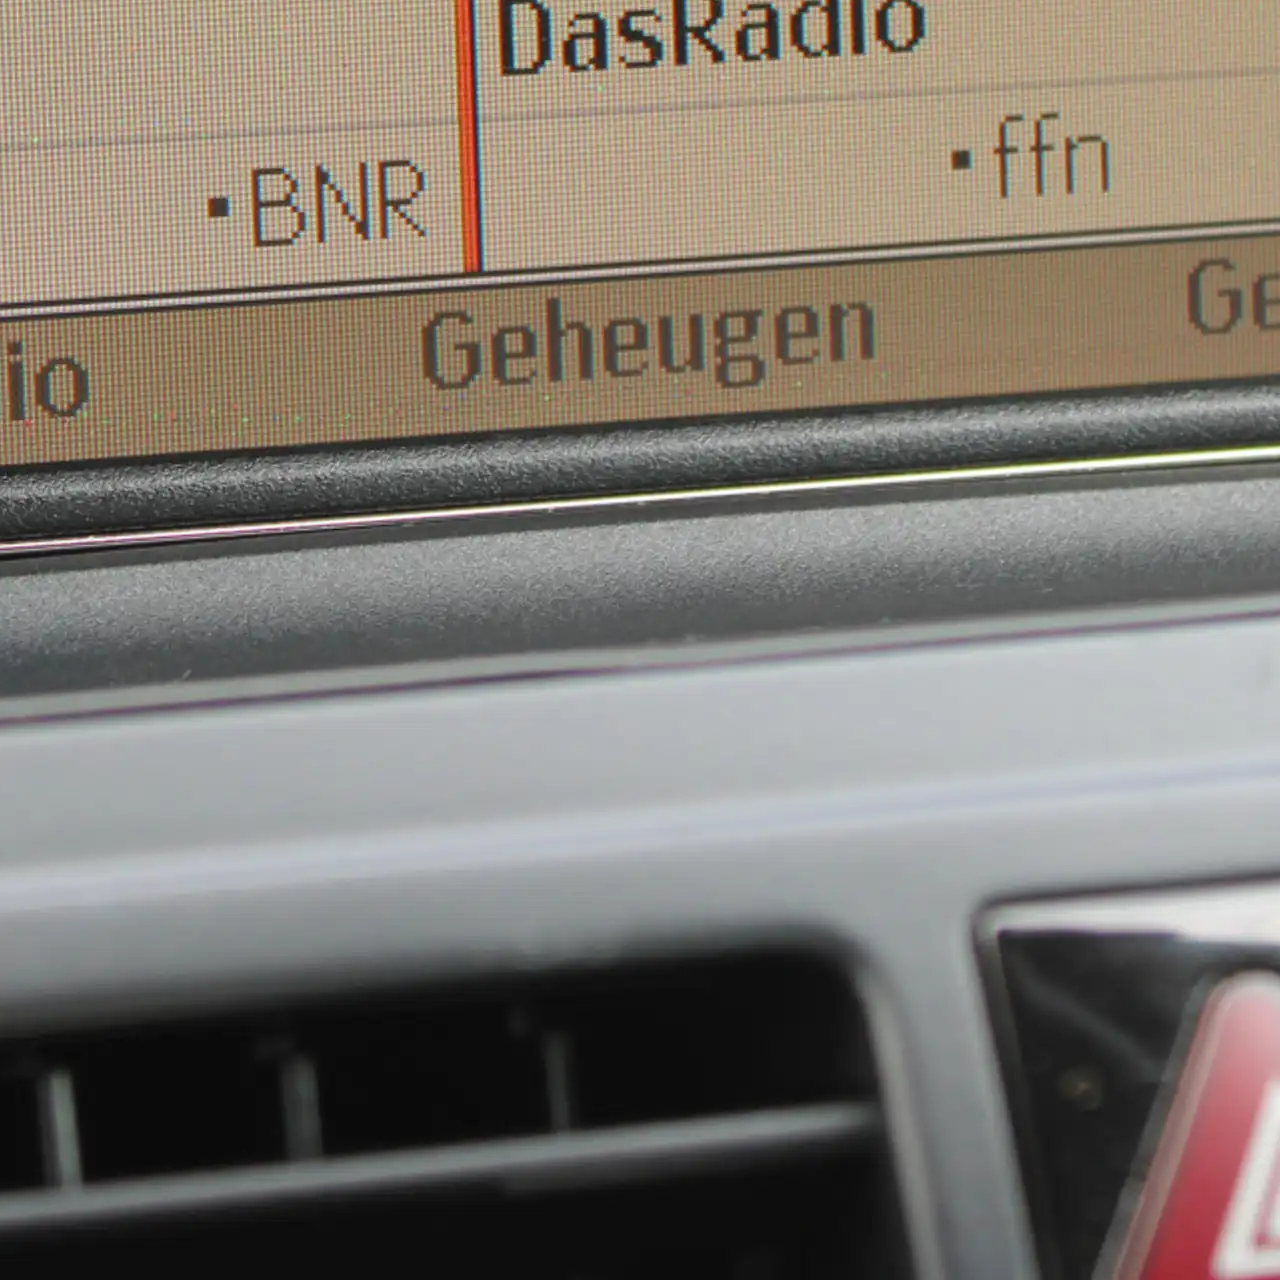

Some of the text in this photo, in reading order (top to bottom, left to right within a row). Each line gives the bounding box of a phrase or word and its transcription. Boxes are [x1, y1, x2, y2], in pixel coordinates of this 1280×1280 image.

[993, 111, 1110, 198] ffn
[251, 158, 426, 248] BNR
[422, 297, 874, 389] Geheugen
